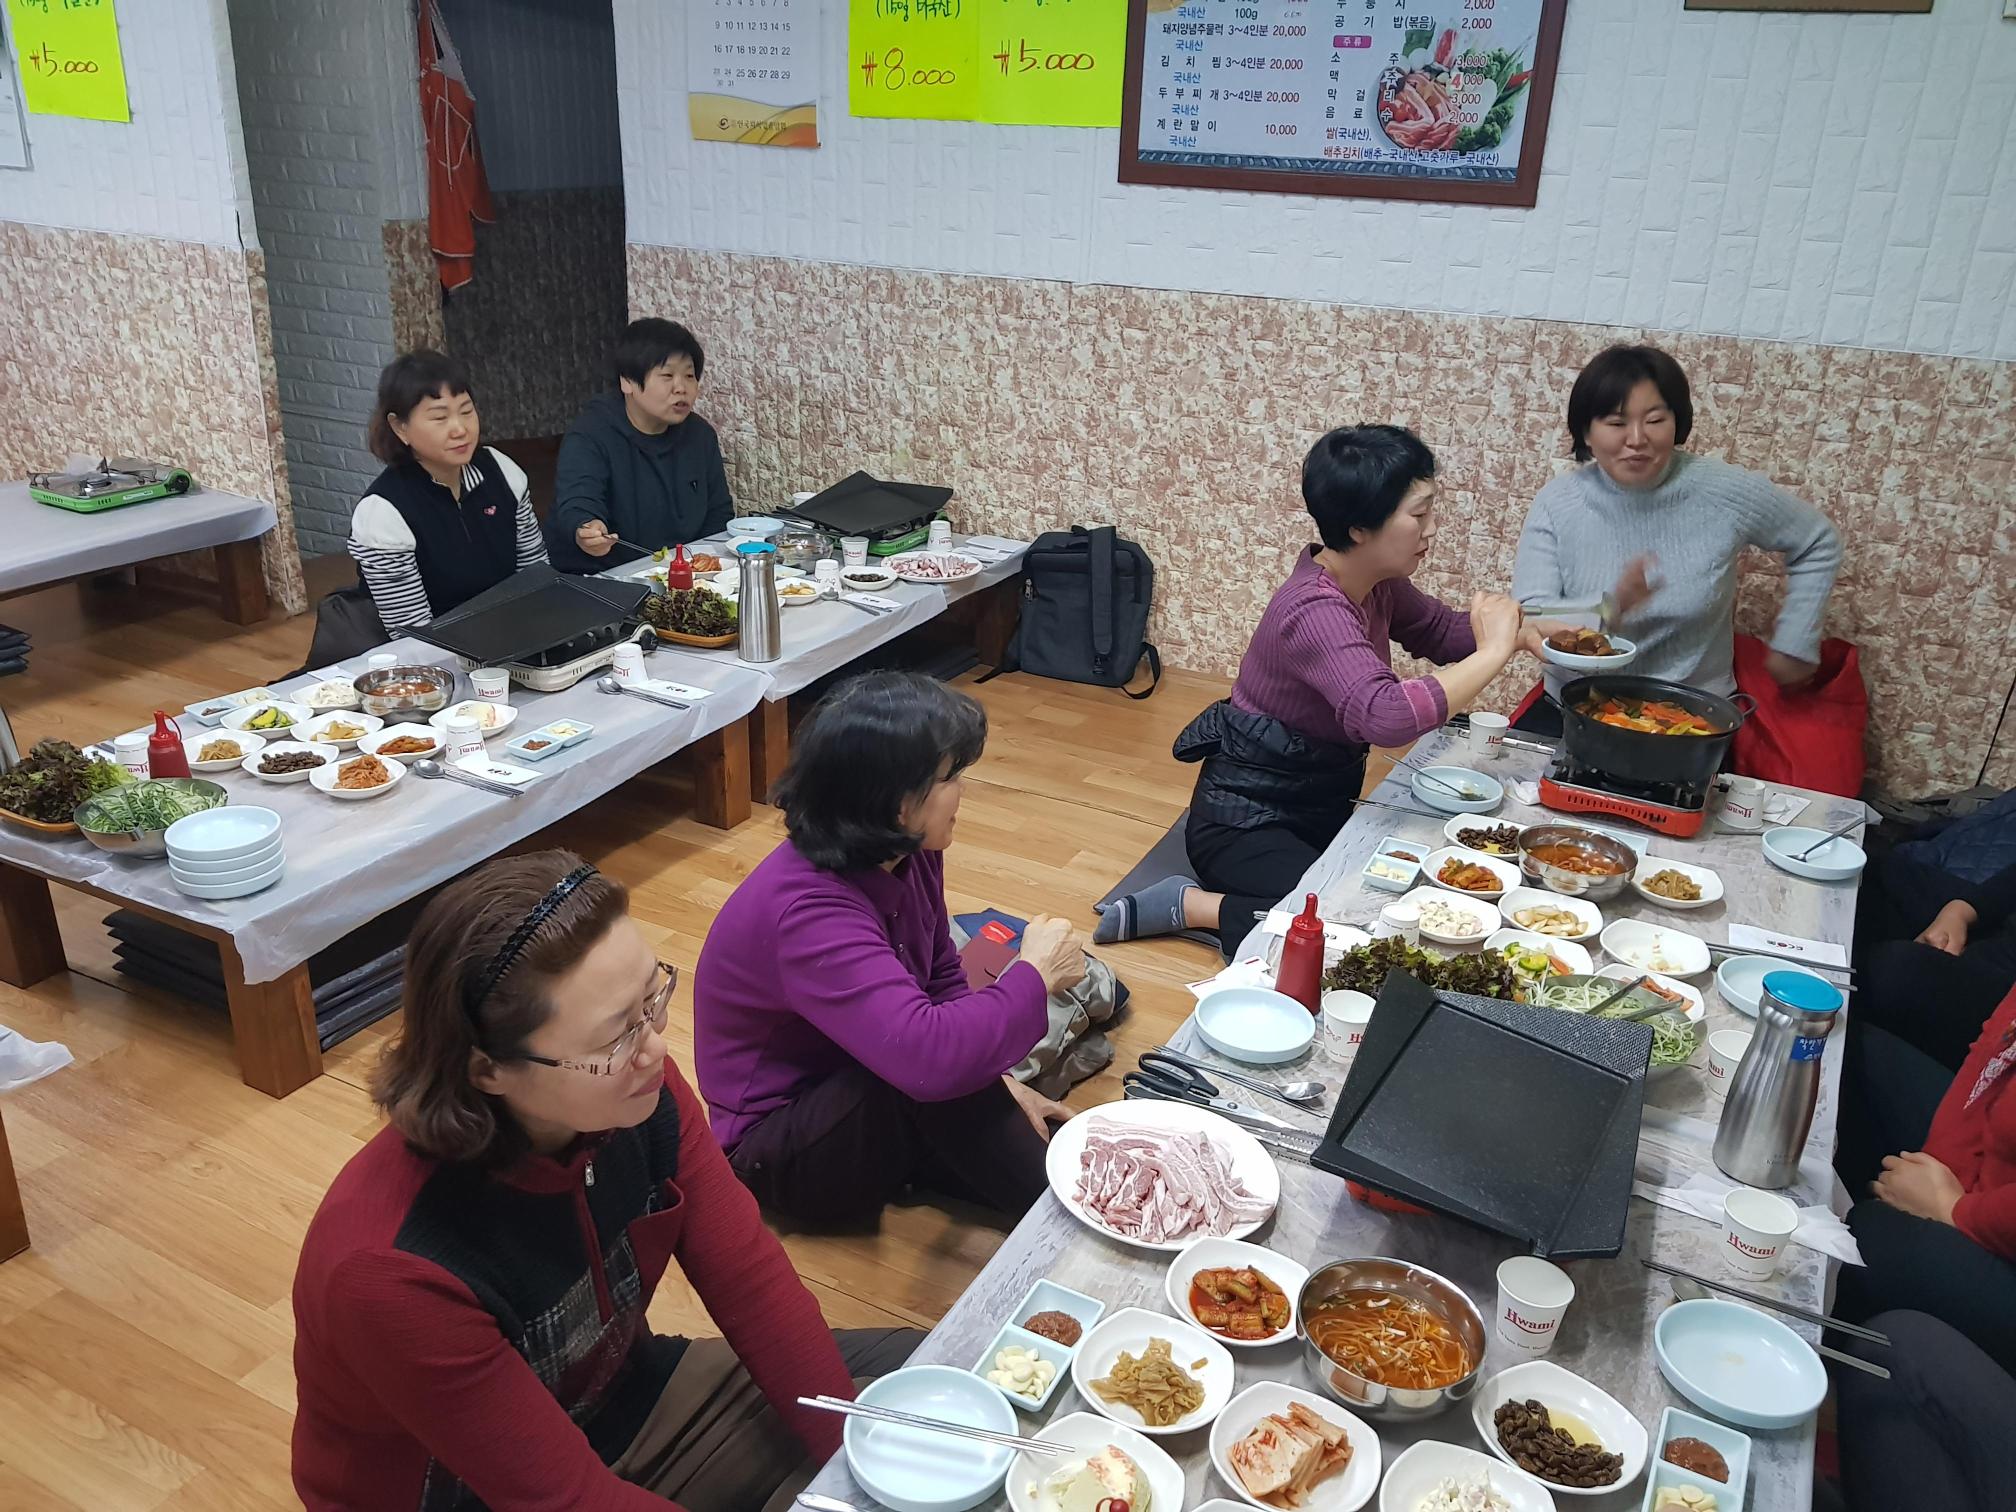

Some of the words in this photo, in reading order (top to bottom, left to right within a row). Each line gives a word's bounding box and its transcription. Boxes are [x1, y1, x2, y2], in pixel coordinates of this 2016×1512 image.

[1463, 0, 1495, 11] 2,000
[1177, 6, 1206, 19] 국내산
[1234, 8, 1258, 20] 100g
[725, 21, 734, 30] 10
[736, 22, 744, 30] 11
[748, 22, 757, 31] 12
[759, 22, 768, 31] 13
[770, 23, 779, 31] 14
[782, 23, 791, 31] 15
[1162, 22, 1224, 36] 돼지양념주물럭
[1272, 25, 1307, 37] 20,000
[1461, 17, 1492, 30] 2,000
[725, 45, 733, 54] 17
[748, 46, 757, 55] 19
[758, 46, 768, 56] 20
[770, 46, 779, 56] 21
[781, 47, 791, 56] 22
[1175, 39, 1204, 52] 국내산
[1269, 58, 1304, 70] 20,000
[1456, 55, 1487, 67] 3,000
[736, 68, 745, 78] 25
[747, 69, 757, 78] 26
[758, 69, 768, 79] 27
[770, 70, 779, 79] 28
[781, 70, 791, 80] 29
[1173, 71, 1201, 84] 국내산
[1266, 91, 1301, 104] 20,000
[1451, 93, 1482, 105] 3,000
[1171, 103, 1199, 116] 국내산
[1449, 111, 1479, 124] 2,000
[1264, 123, 1297, 136] 10,000
[1169, 134, 1197, 148] 국내산
[1728, 1232, 1777, 1256] Hwami
[1506, 1307, 1556, 1330] Hwami
